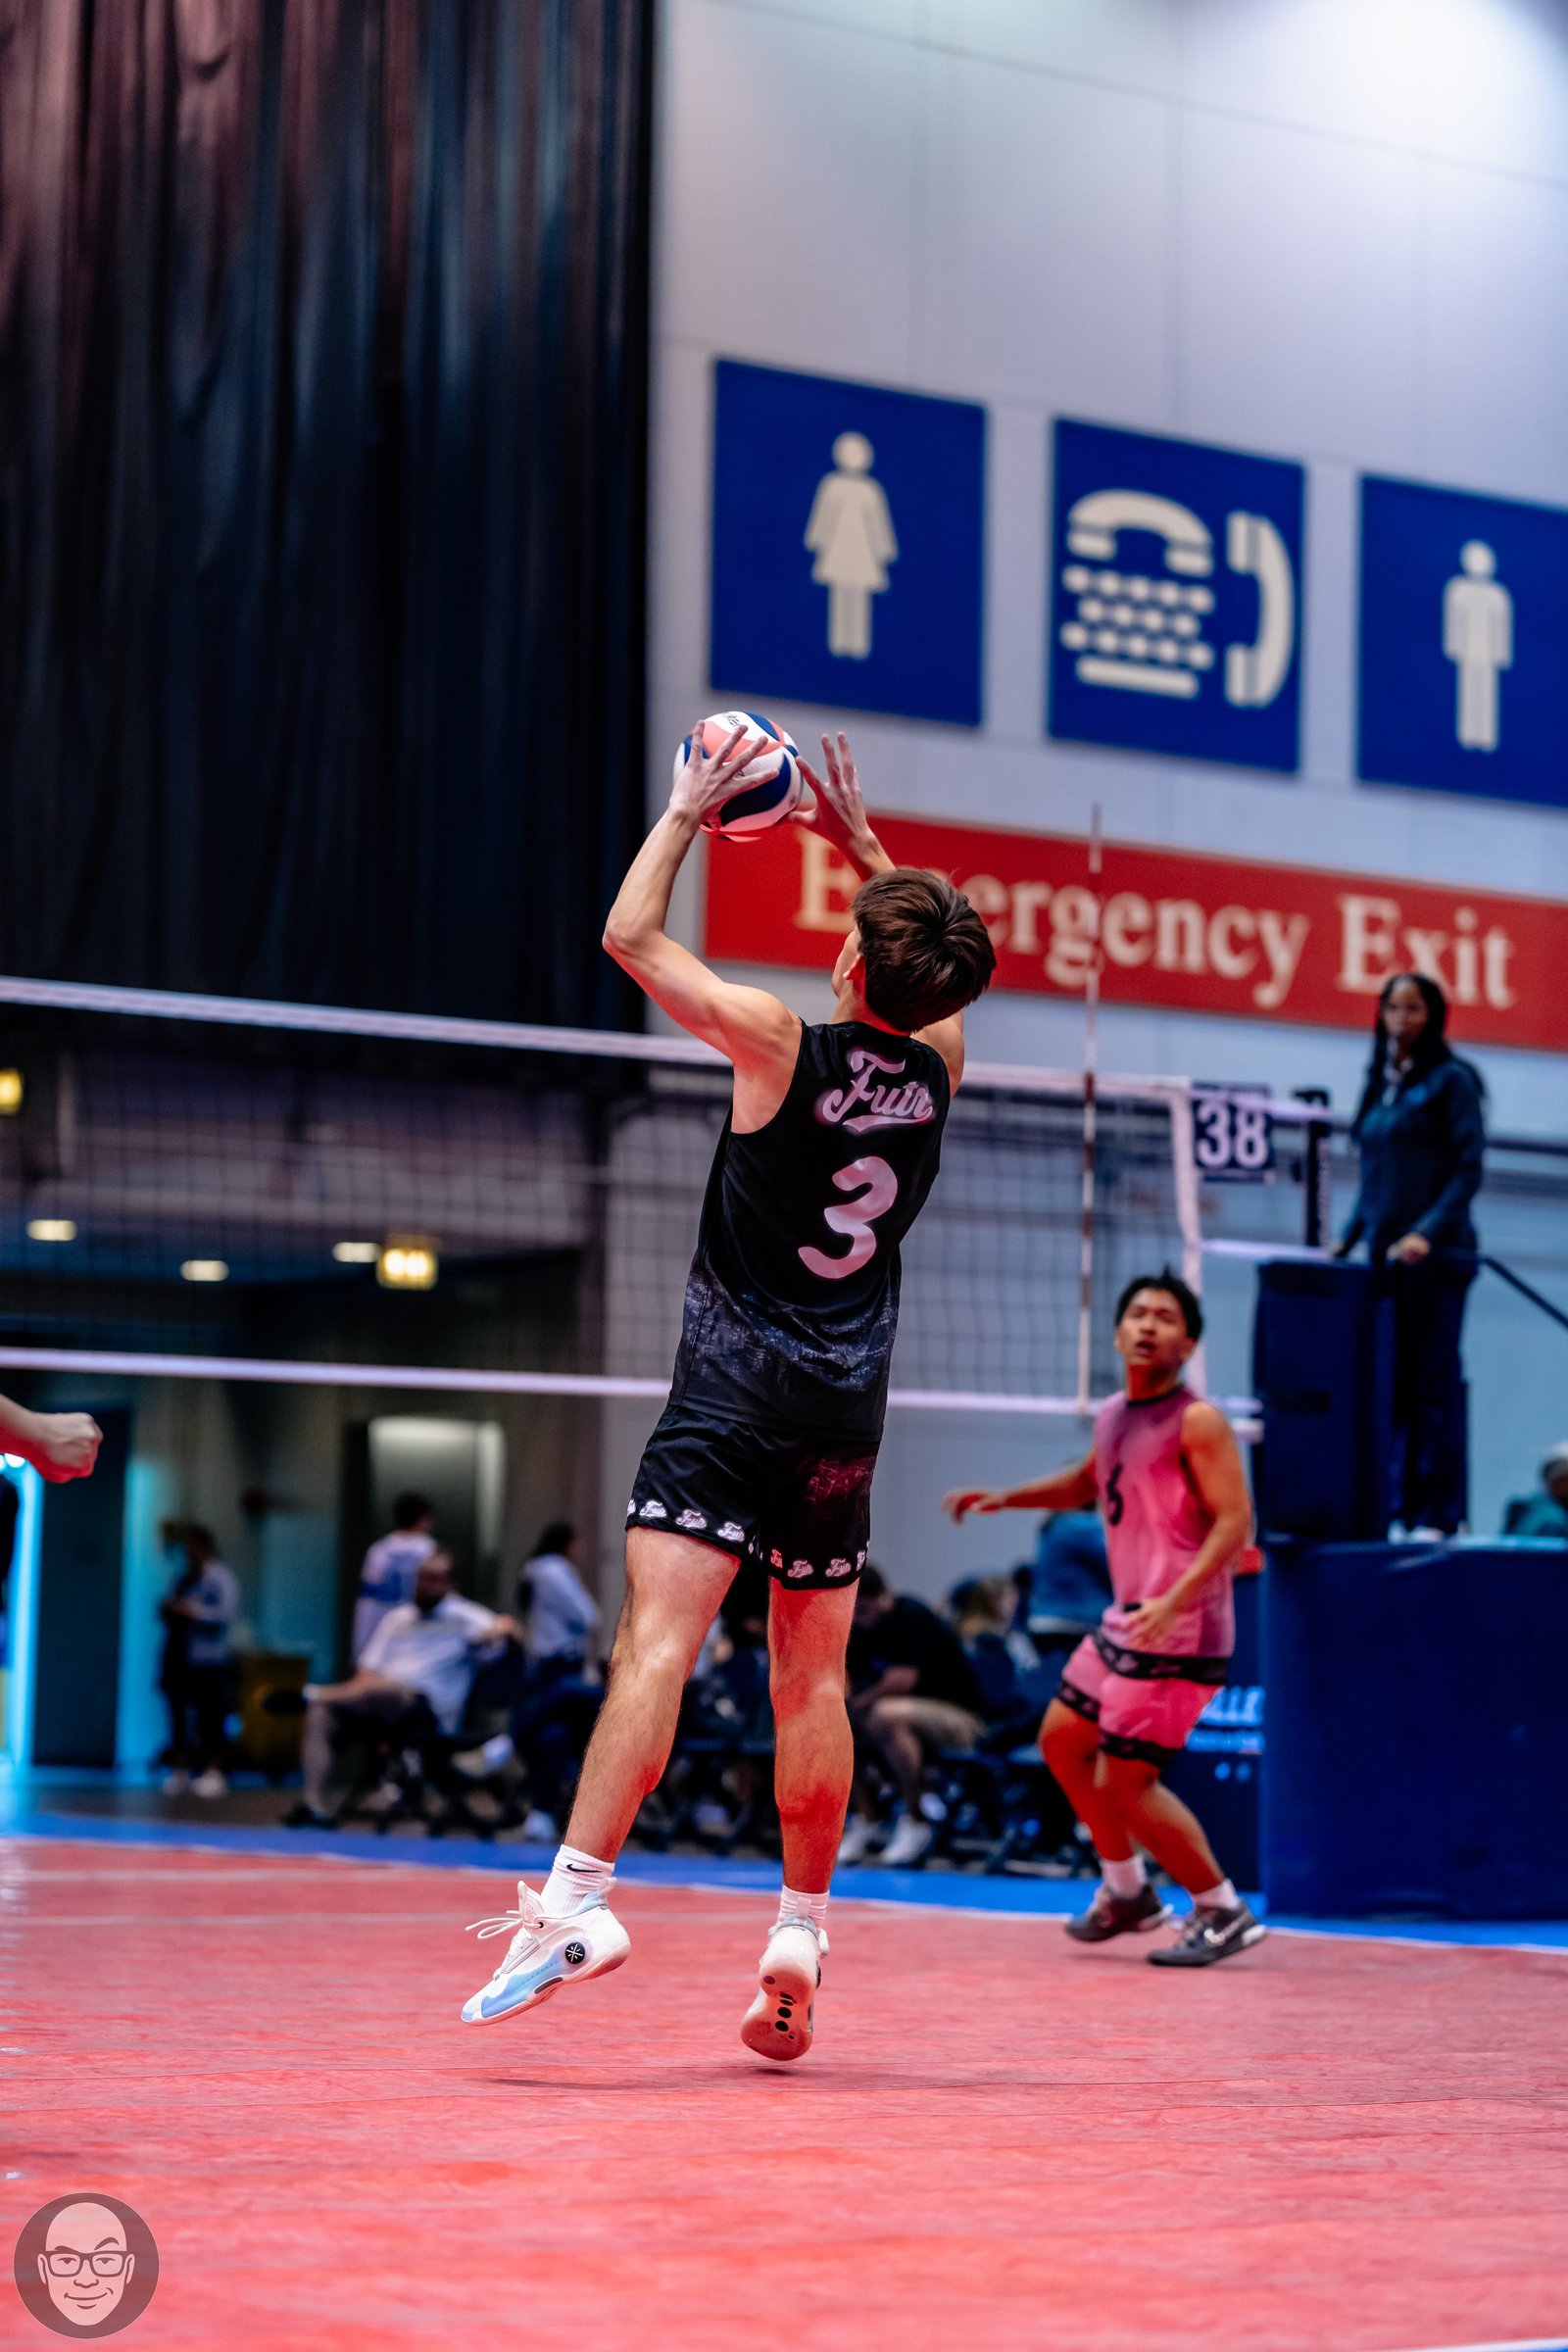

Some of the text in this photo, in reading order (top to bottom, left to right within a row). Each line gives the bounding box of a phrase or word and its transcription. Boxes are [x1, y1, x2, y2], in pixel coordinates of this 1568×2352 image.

[795, 825, 1516, 1010] Eergency Exit
[1197, 1098, 1269, 1168] 38
[797, 1155, 899, 1279] 3
